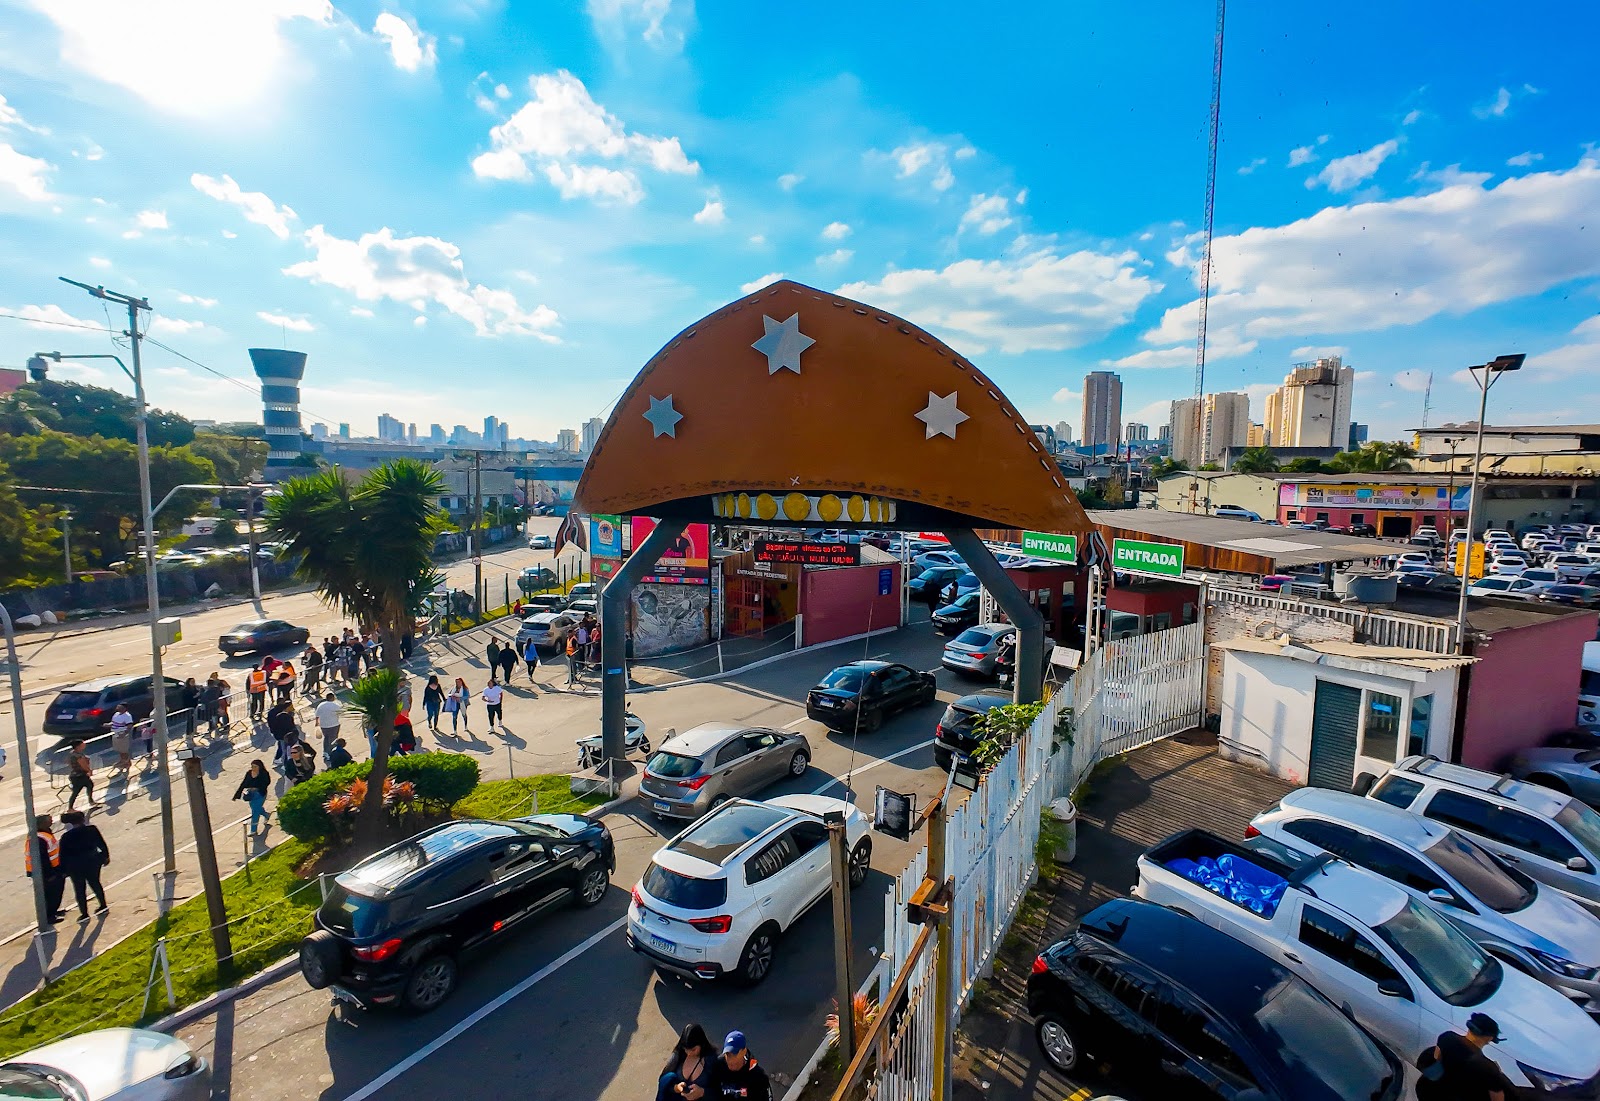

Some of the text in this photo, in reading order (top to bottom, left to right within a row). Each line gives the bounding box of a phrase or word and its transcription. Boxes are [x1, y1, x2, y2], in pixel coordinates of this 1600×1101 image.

[1025, 538, 1072, 554] ENTRADA
[1117, 548, 1178, 567] ENTRADA
[736, 568, 756, 576] ENTRADA
[764, 571, 788, 580] PEDESTRES
